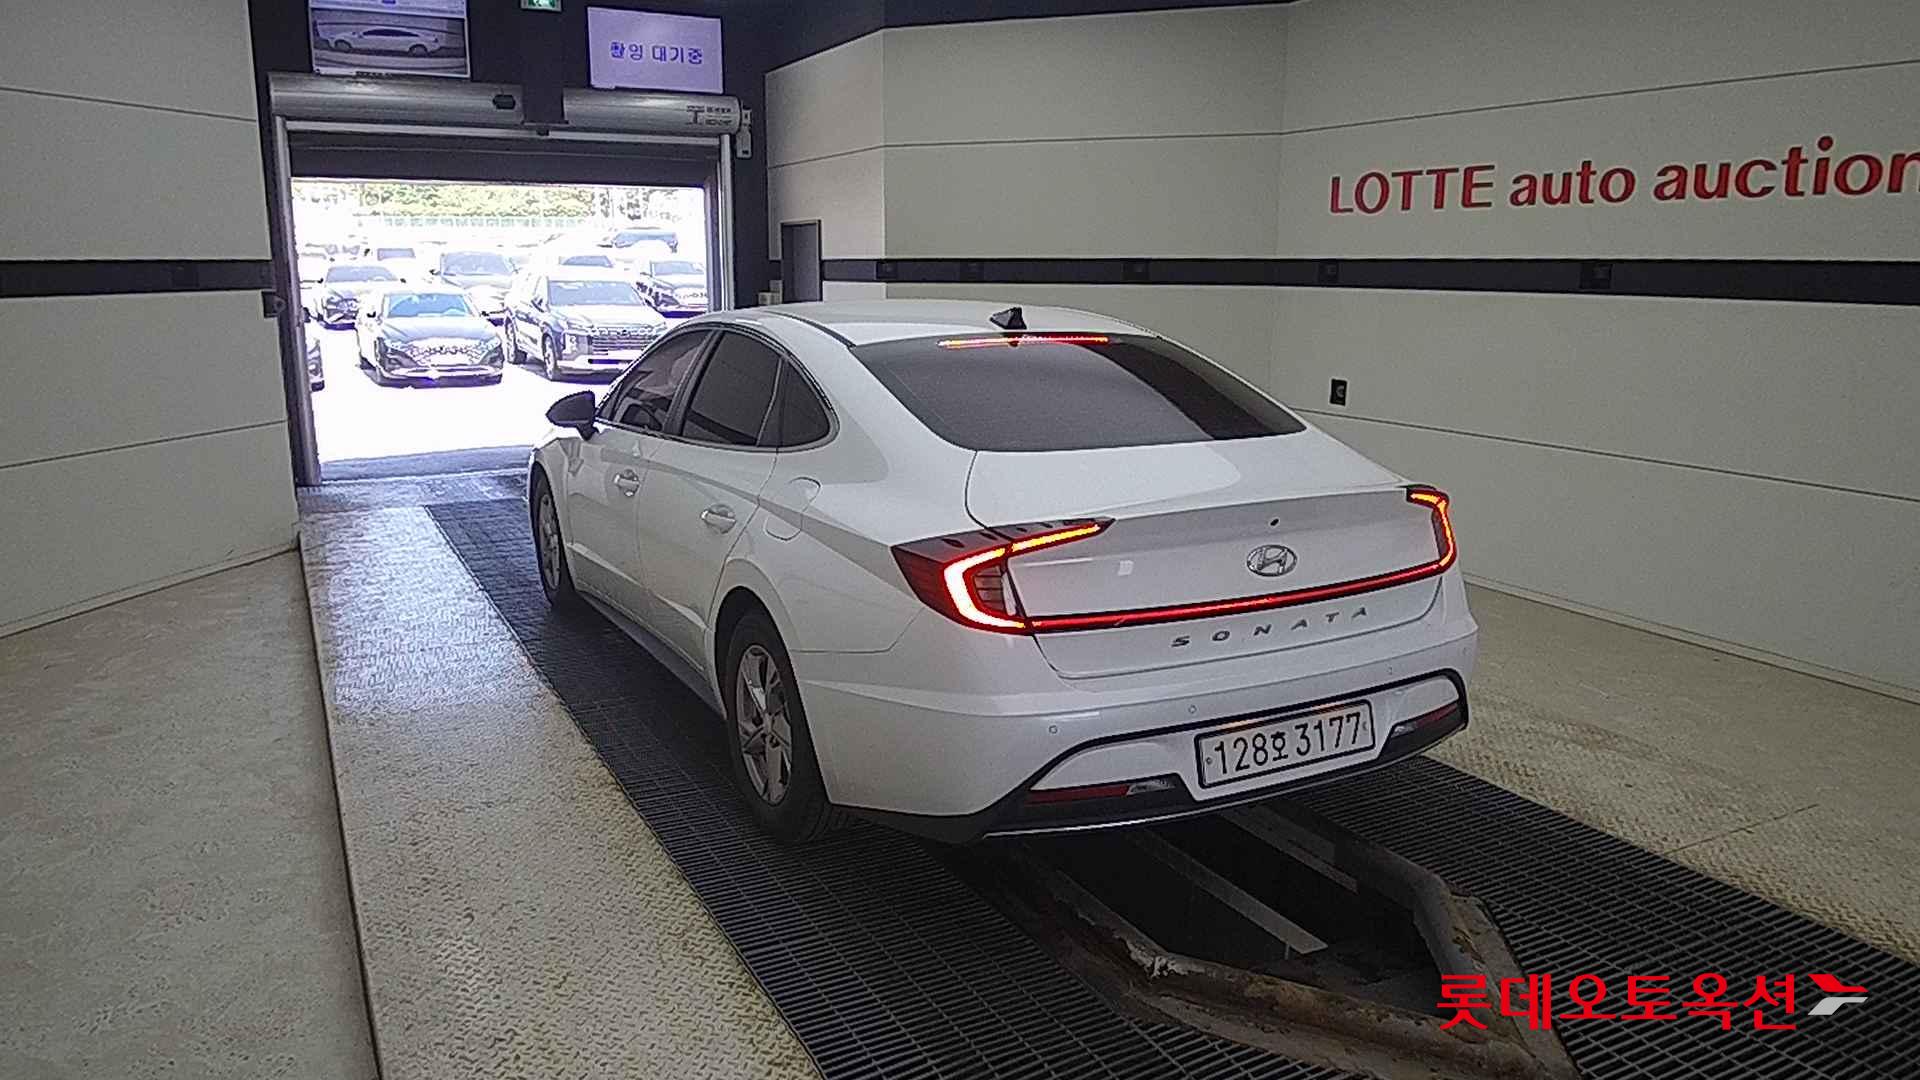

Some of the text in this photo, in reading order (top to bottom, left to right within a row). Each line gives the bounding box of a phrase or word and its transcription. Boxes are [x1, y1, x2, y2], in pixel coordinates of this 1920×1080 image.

[651, 45, 703, 65] 대기중
[1329, 164, 1496, 215] LOTTE
[1509, 160, 1636, 207] auto
[1171, 607, 1367, 648] SONATA
